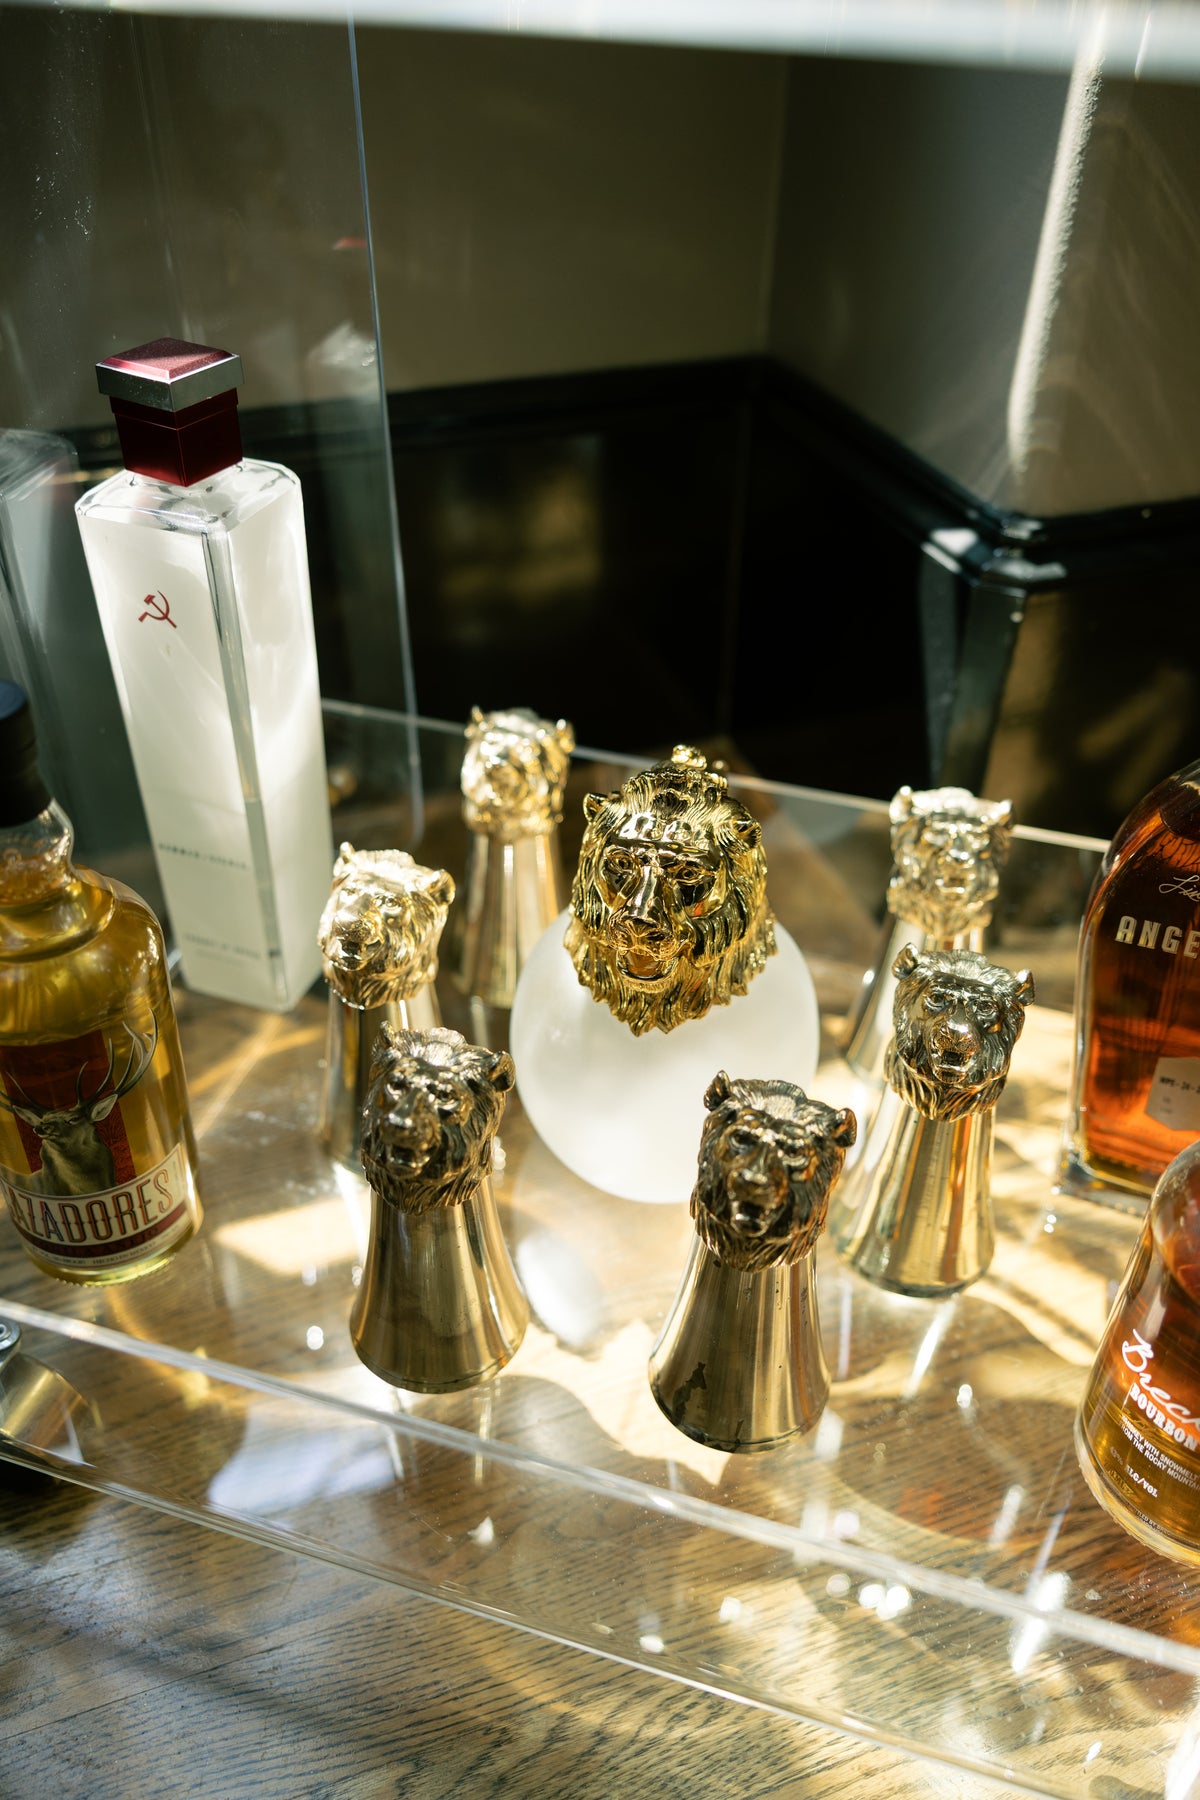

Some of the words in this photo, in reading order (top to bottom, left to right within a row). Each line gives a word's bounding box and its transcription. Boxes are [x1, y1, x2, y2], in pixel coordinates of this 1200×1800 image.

[2, 1168, 172, 1243] AZADORES
[1129, 1383, 1199, 1452] BOURBON
[1133, 1437, 1145, 1454] THE
[1144, 1451, 1168, 1471] ROCKY
